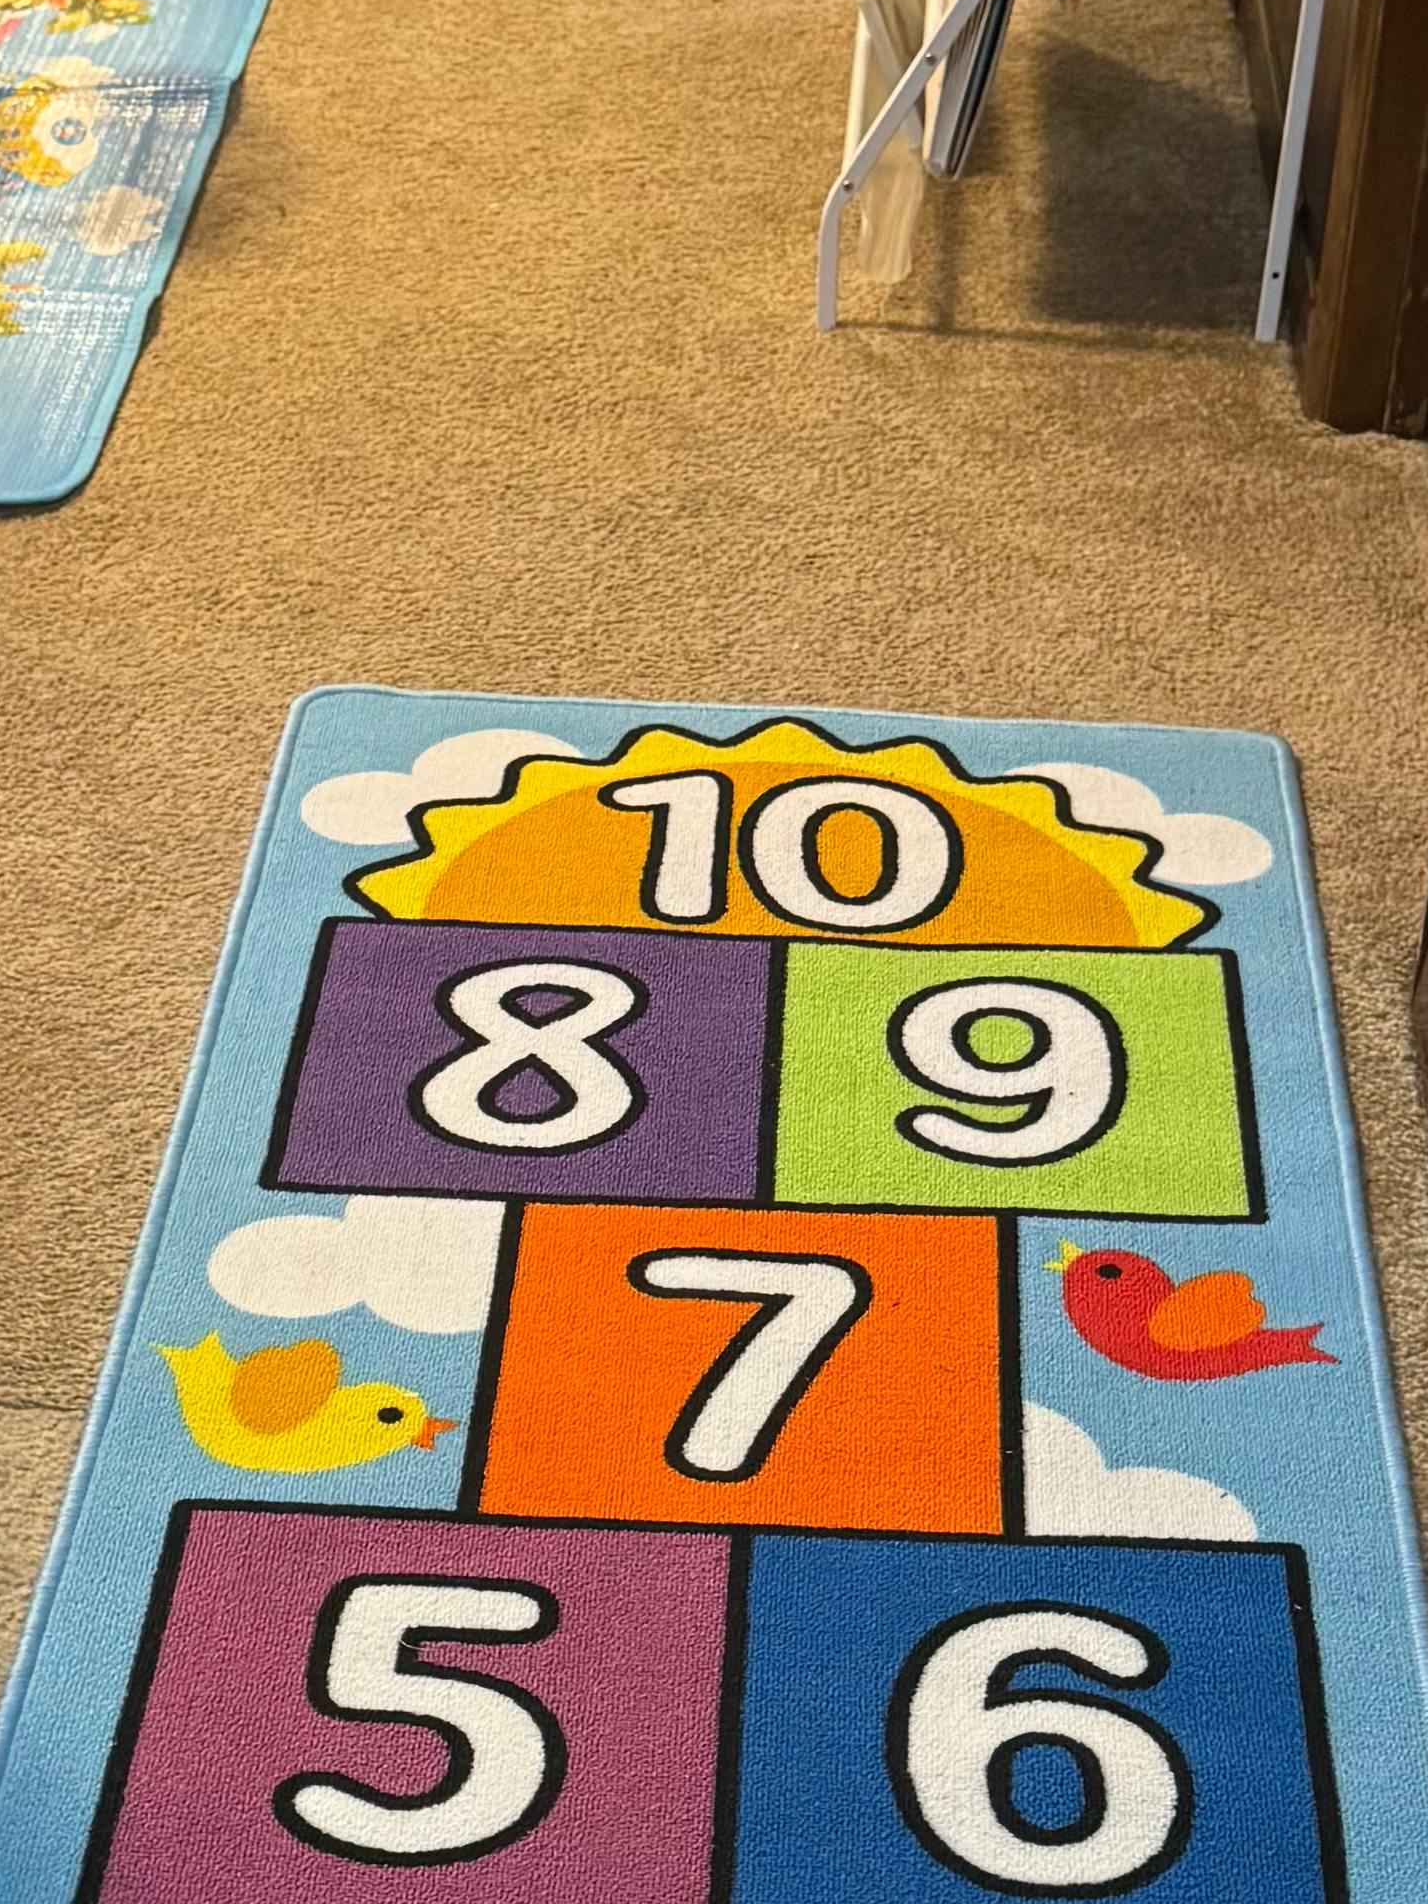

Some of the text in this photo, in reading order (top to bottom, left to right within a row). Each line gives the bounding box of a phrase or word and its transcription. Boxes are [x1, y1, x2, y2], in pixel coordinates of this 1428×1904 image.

[603, 773, 960, 934] 10
[415, 957, 644, 1156] 8
[892, 977, 1125, 1166] 9
[630, 1250, 868, 1480] 7
[285, 1577, 557, 1864] 5
[896, 1604, 1188, 1896] 6
